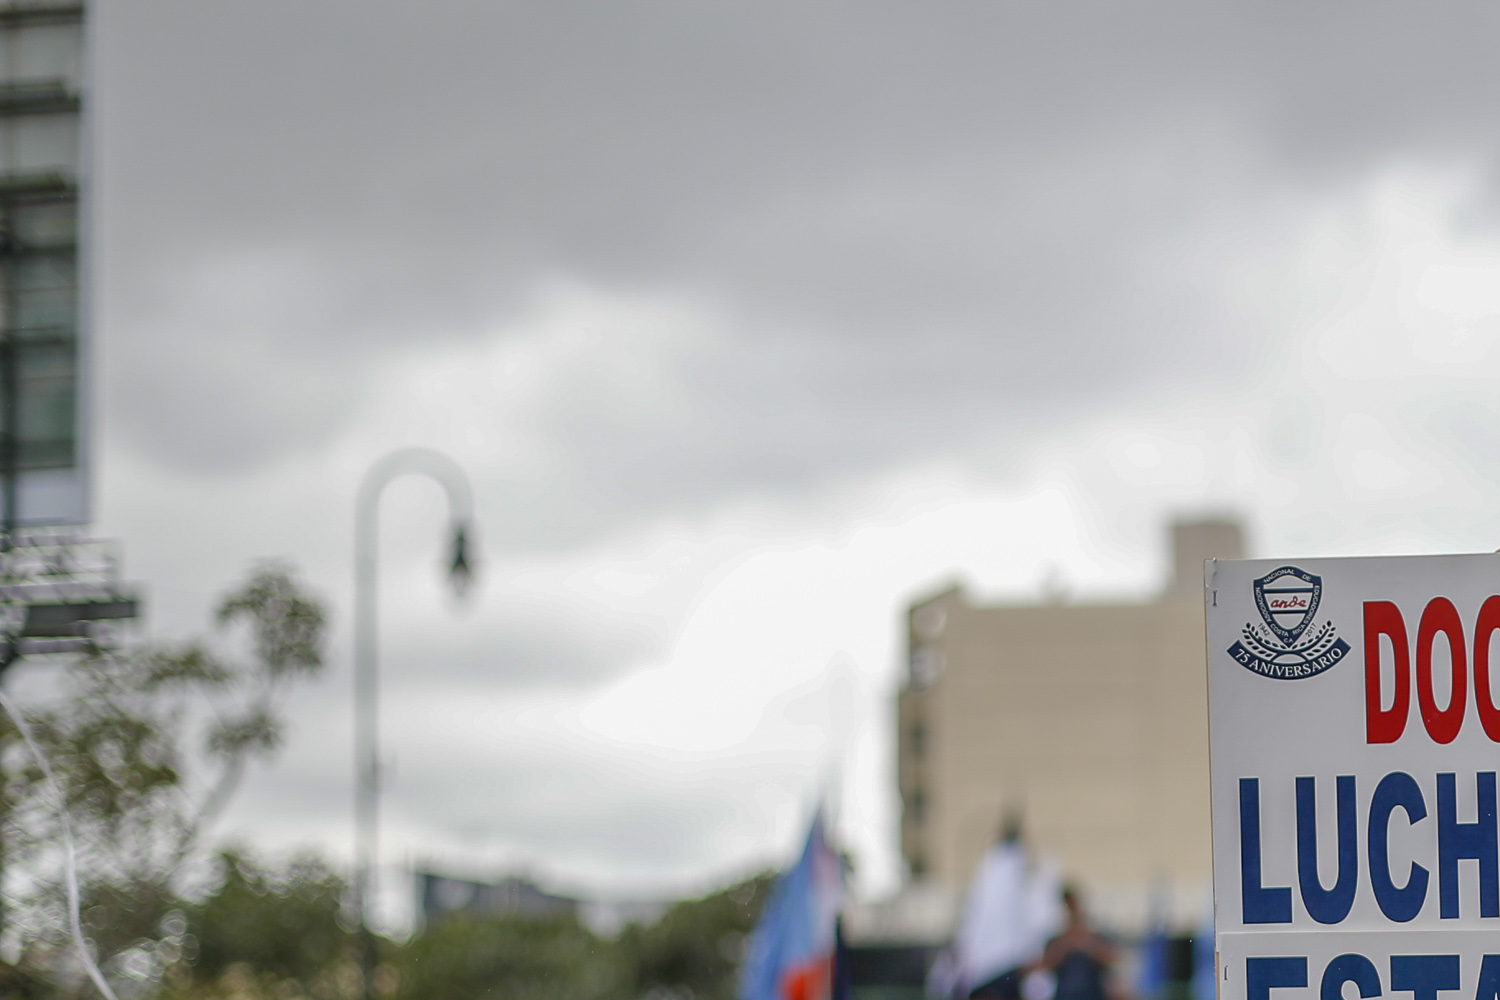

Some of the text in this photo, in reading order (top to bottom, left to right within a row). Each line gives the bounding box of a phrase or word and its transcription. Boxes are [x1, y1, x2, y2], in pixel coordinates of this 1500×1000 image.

[1263, 568, 1295, 583] NACIONAL
[1302, 574, 1311, 582] DE
[1270, 596, 1307, 609] ande
[1304, 585, 1320, 623] EDUCADORES
[1258, 623, 1270, 637] 1942
[1271, 623, 1305, 637] COSTA RICA
[1305, 622, 1317, 637] 2017
[1235, 647, 1342, 677] 75 ANIVERSARIO
